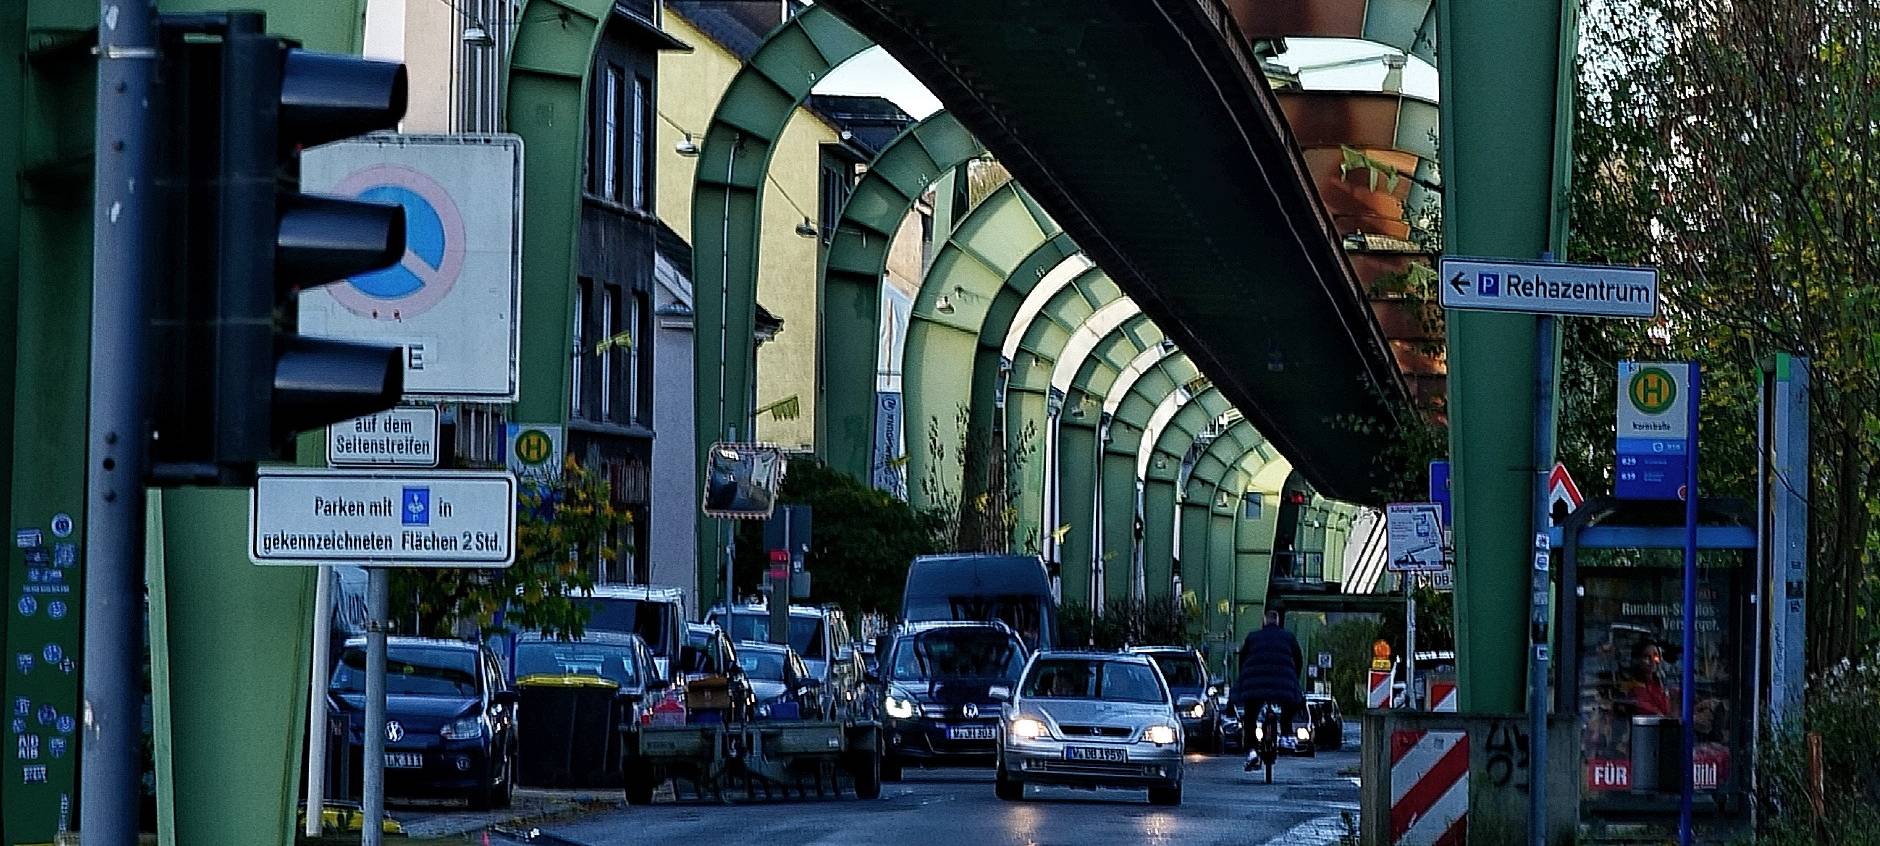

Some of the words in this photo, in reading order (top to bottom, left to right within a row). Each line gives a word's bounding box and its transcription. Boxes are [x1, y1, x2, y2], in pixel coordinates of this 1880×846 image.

[1507, 274, 1650, 303] Rehazentrum
[1644, 378, 1662, 403] H
[355, 417, 377, 432] auf
[384, 417, 412, 433] dem
[336, 436, 430, 454] Seitenstreifen
[527, 438, 541, 460] H
[315, 496, 365, 517] Parken
[370, 497, 393, 517] mit
[439, 496, 453, 517] in
[263, 529, 393, 555] gekennzeichneten
[402, 530, 458, 551] Flächen
[462, 531, 472, 551] 2
[475, 531, 502, 551] Std.
[1594, 760, 1628, 786] FÜR
